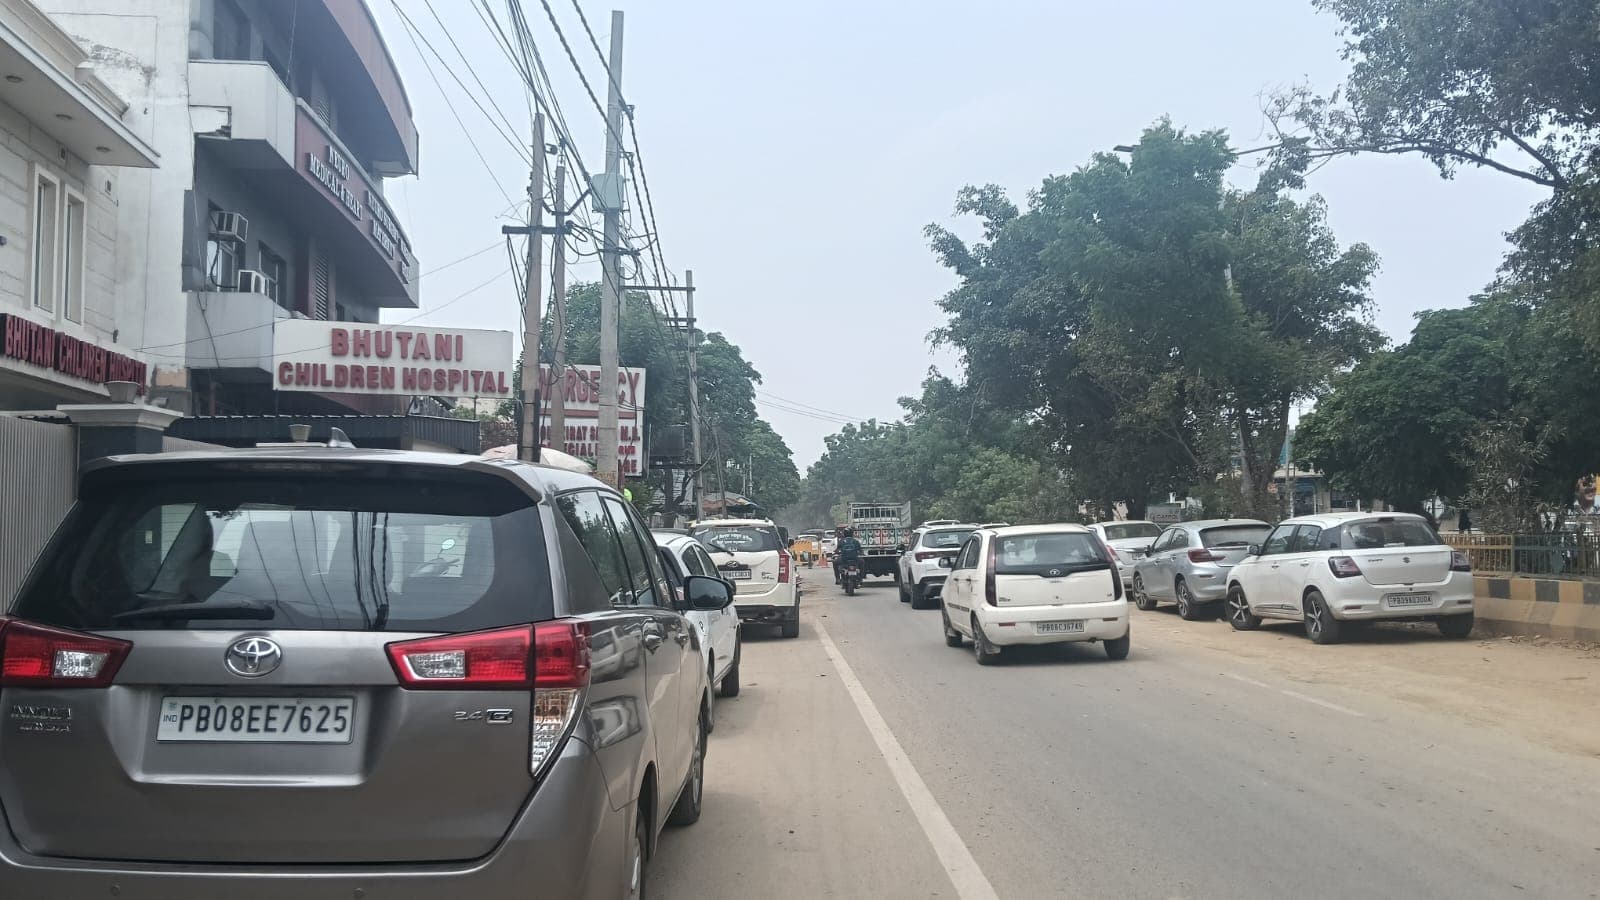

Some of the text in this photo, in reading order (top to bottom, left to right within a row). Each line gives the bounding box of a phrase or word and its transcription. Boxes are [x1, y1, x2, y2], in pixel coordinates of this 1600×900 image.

[5, 312, 56, 368] BHUTANI
[58, 331, 107, 384] CHILDREN
[331, 327, 464, 361] BHUTANI
[278, 361, 510, 394] CHILDREN HOSPITAL
[163, 705, 349, 733] IND PB08EE7625
